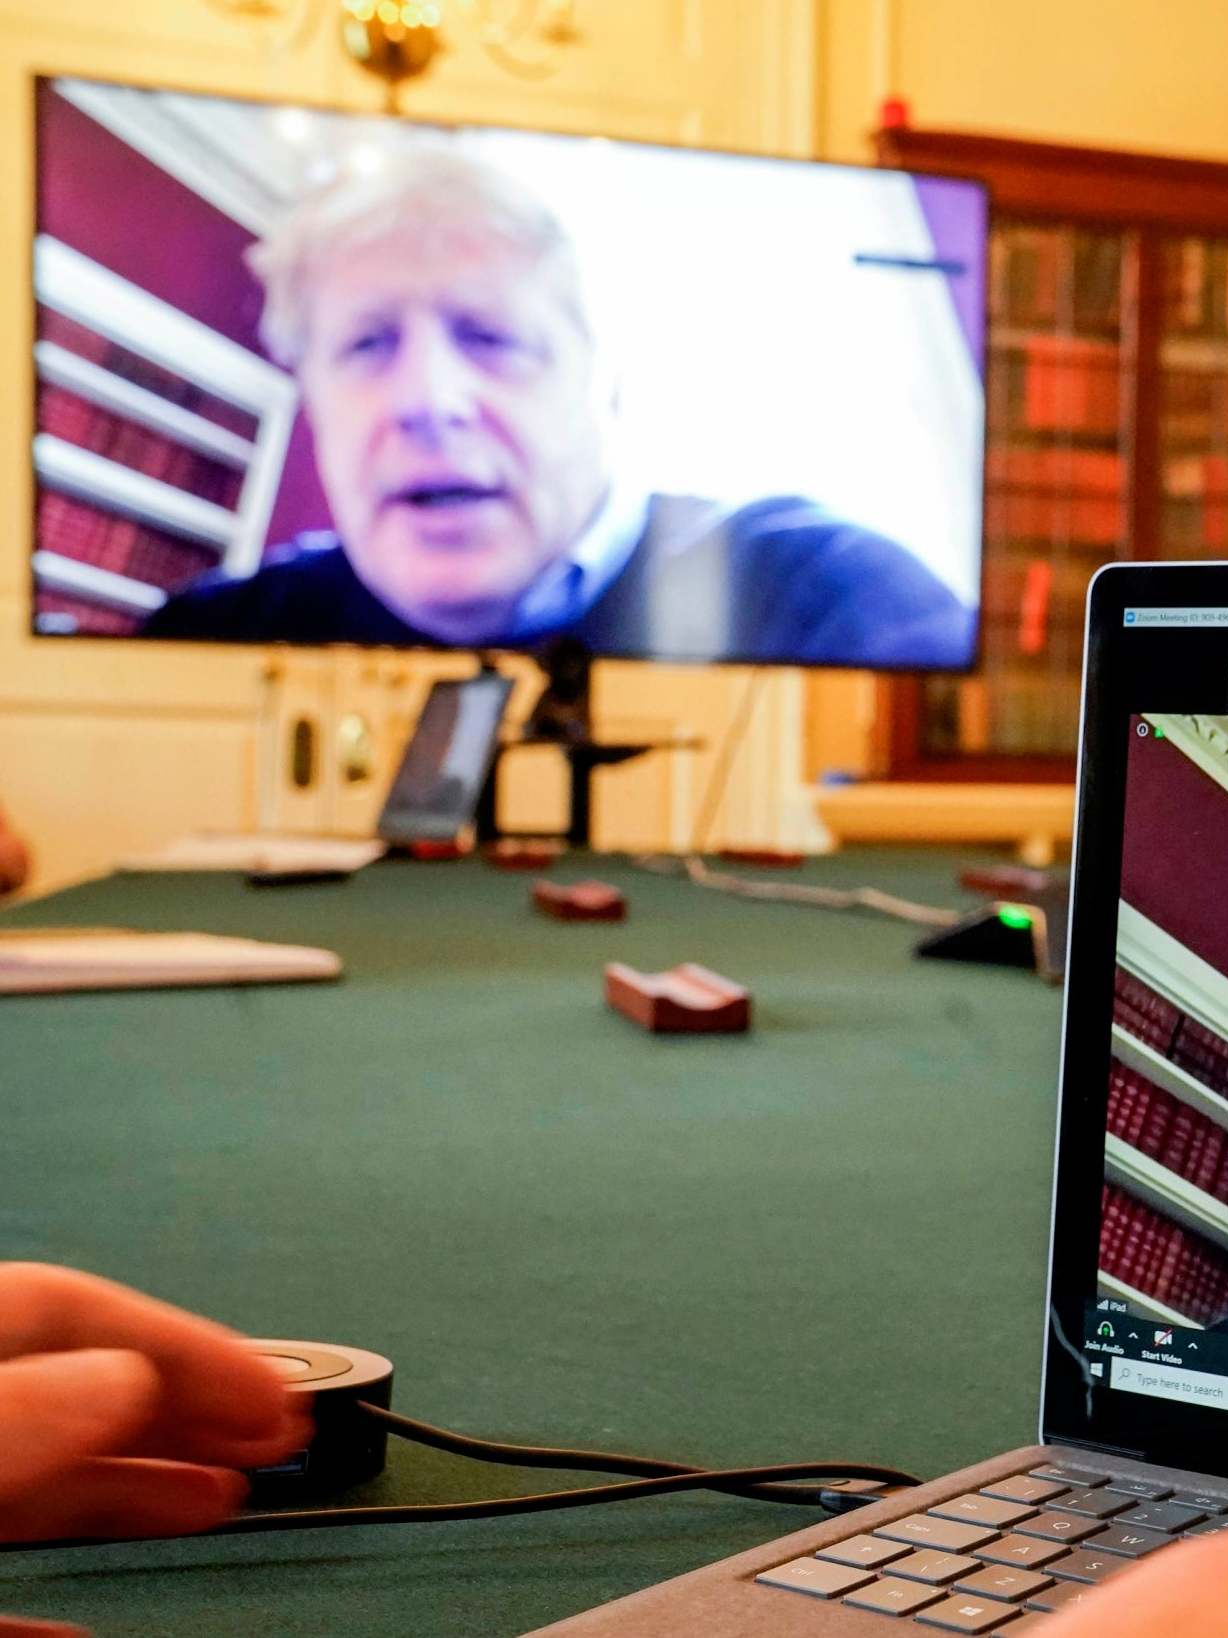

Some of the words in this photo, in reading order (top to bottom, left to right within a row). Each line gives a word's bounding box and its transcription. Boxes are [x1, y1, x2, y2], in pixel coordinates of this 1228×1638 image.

[1160, 612, 1188, 623] Meeting
[1109, 1302, 1126, 1312] iPad
[1084, 1340, 1101, 1351] Join
[1101, 1343, 1124, 1355] Audio
[1141, 1350, 1160, 1361] Start
[1161, 1354, 1183, 1365] Video
[1137, 1373, 1158, 1386] Type
[1160, 1376, 1180, 1389] here
[1182, 1380, 1191, 1392] to
[1194, 1383, 1223, 1398] search
[1120, 1535, 1144, 1544] W
[1012, 1546, 1031, 1554] A
